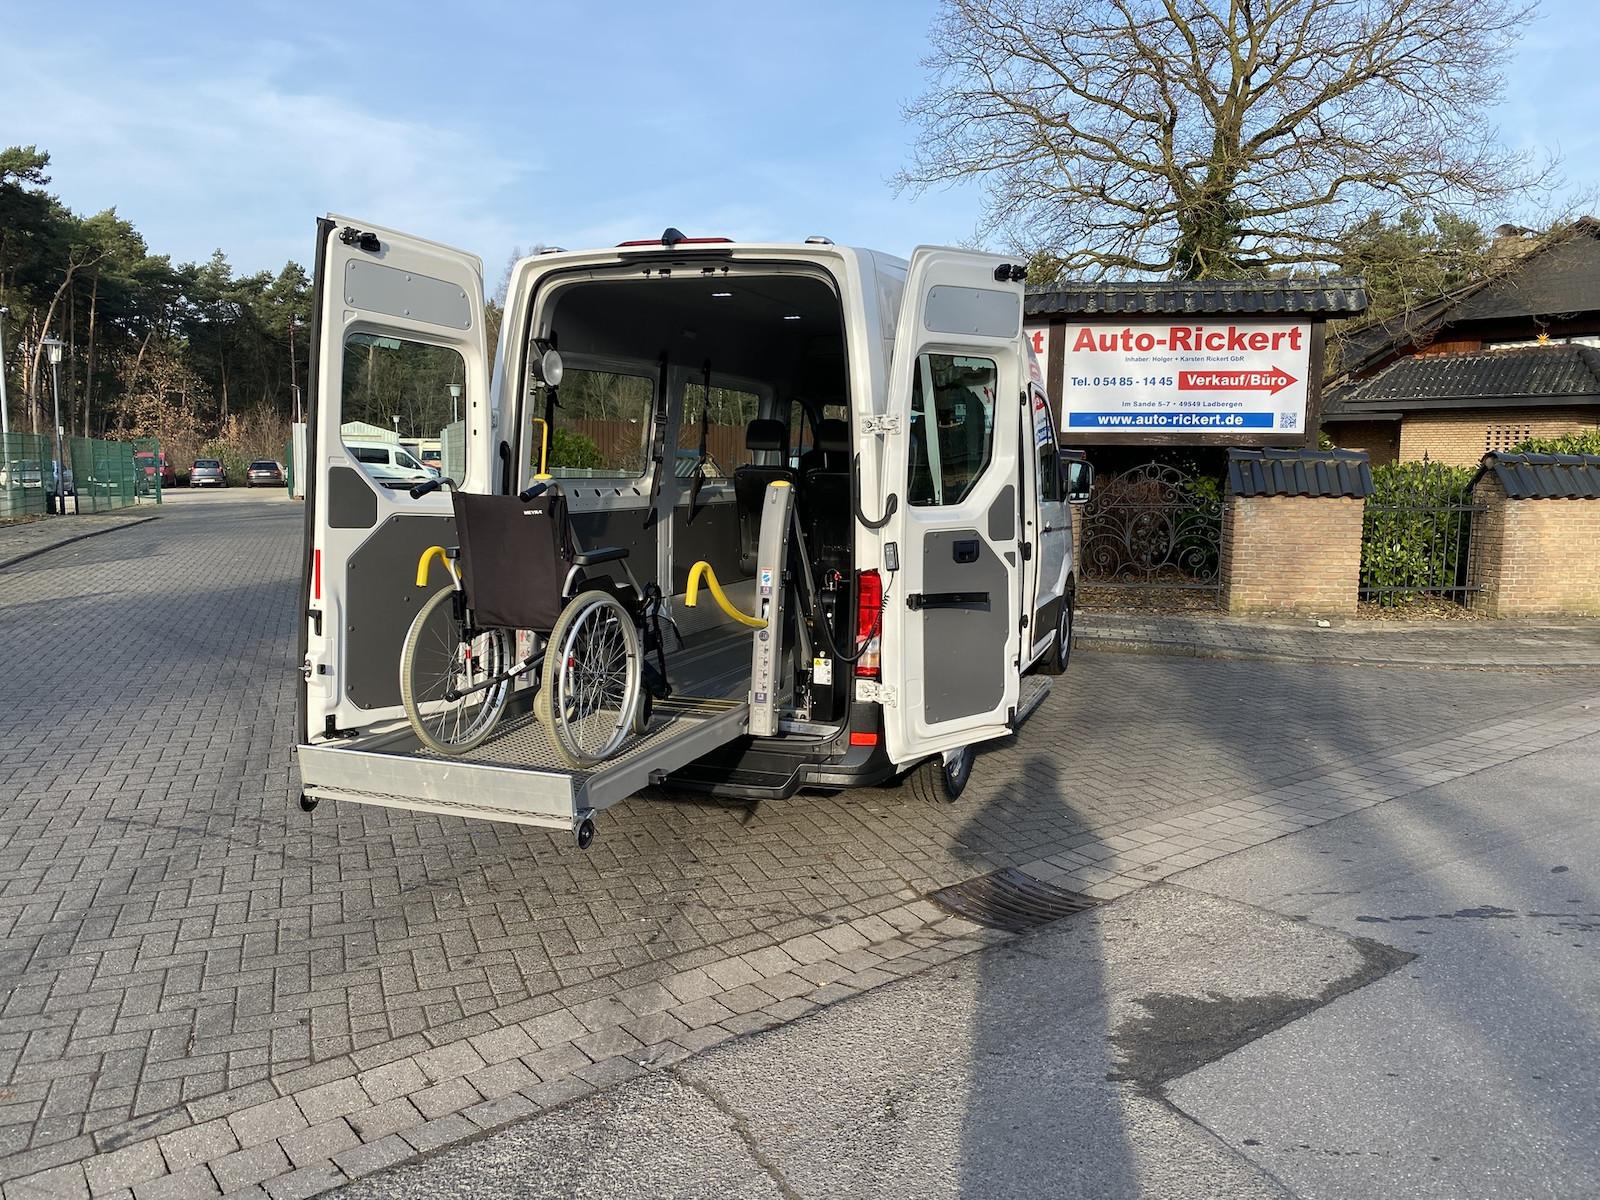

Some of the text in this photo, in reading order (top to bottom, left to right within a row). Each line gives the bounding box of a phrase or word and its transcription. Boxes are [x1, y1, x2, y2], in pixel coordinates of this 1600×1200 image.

[1072, 327, 1302, 352] Auto-Rickert
[1071, 377, 1090, 386] Tel.
[1187, 374, 1287, 387] Verkauf/Büro
[1098, 414, 1243, 425] www.auto-rickert.de
